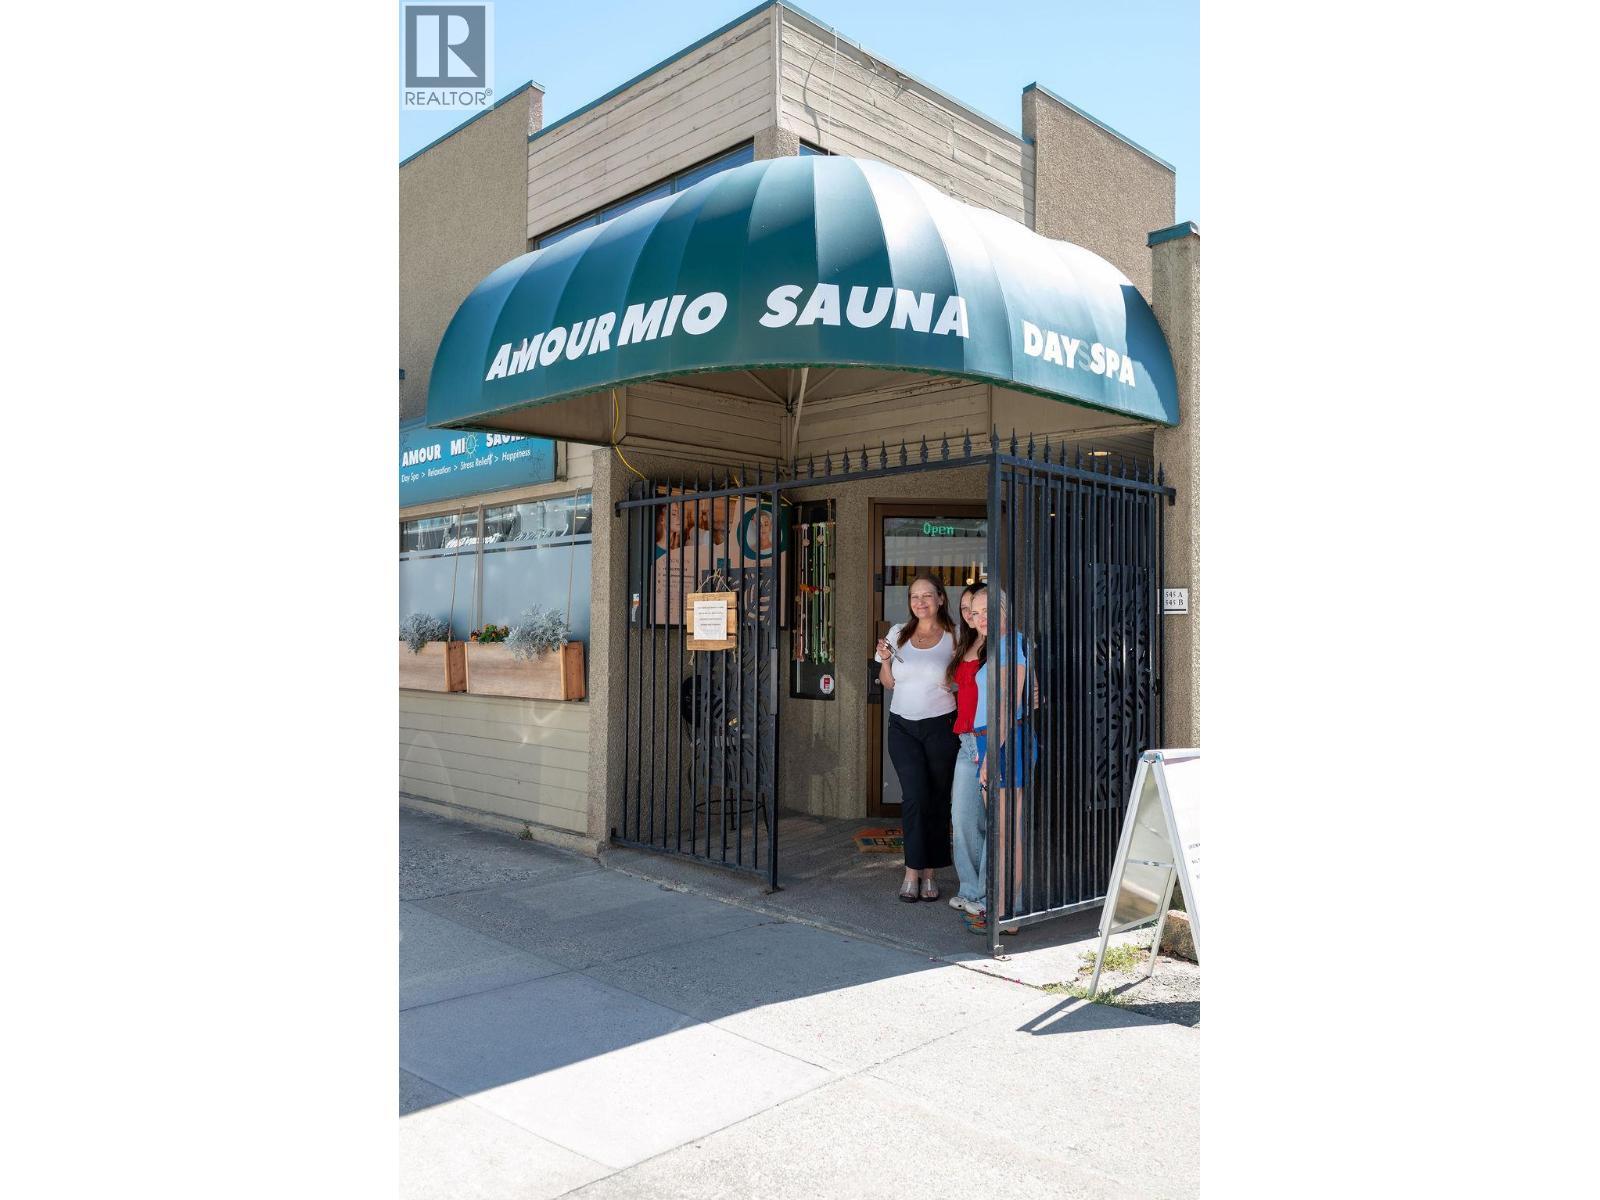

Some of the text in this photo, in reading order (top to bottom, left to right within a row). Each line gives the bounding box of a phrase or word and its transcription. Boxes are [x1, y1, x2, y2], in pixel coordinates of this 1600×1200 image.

[485, 282, 1136, 388] AMOUR MIO SAUNA DAY SPA
[402, 444, 441, 467] AMOUR
[501, 449, 531, 463] Happiness
[923, 522, 954, 537] Open
